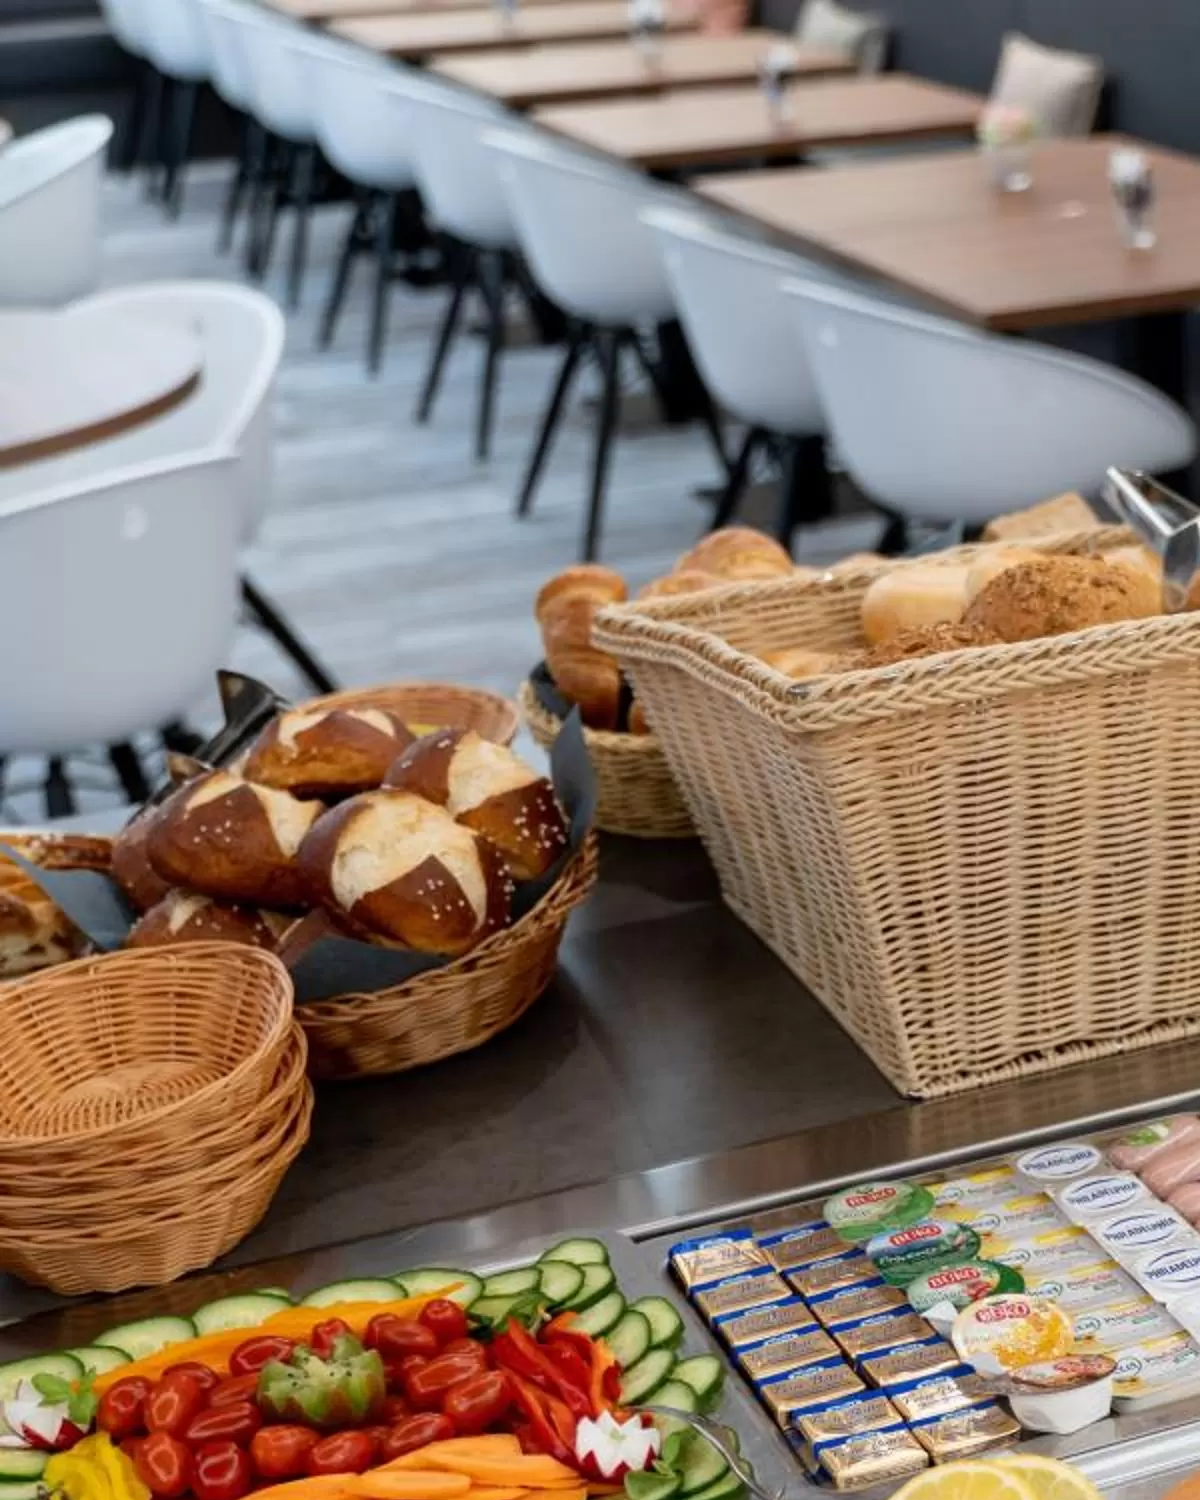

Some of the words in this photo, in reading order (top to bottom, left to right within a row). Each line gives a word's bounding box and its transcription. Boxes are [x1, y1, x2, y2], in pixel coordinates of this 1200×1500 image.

[1022, 1149, 1093, 1172] PHILADELPHIA
[1067, 1181, 1139, 1205] PHILADELPHIA
[891, 1225, 942, 1245] BUKO
[1103, 1216, 1178, 1241] PHILADELPHIA
[929, 1268, 981, 1289] BUKO
[977, 1302, 1030, 1323] BUKO
